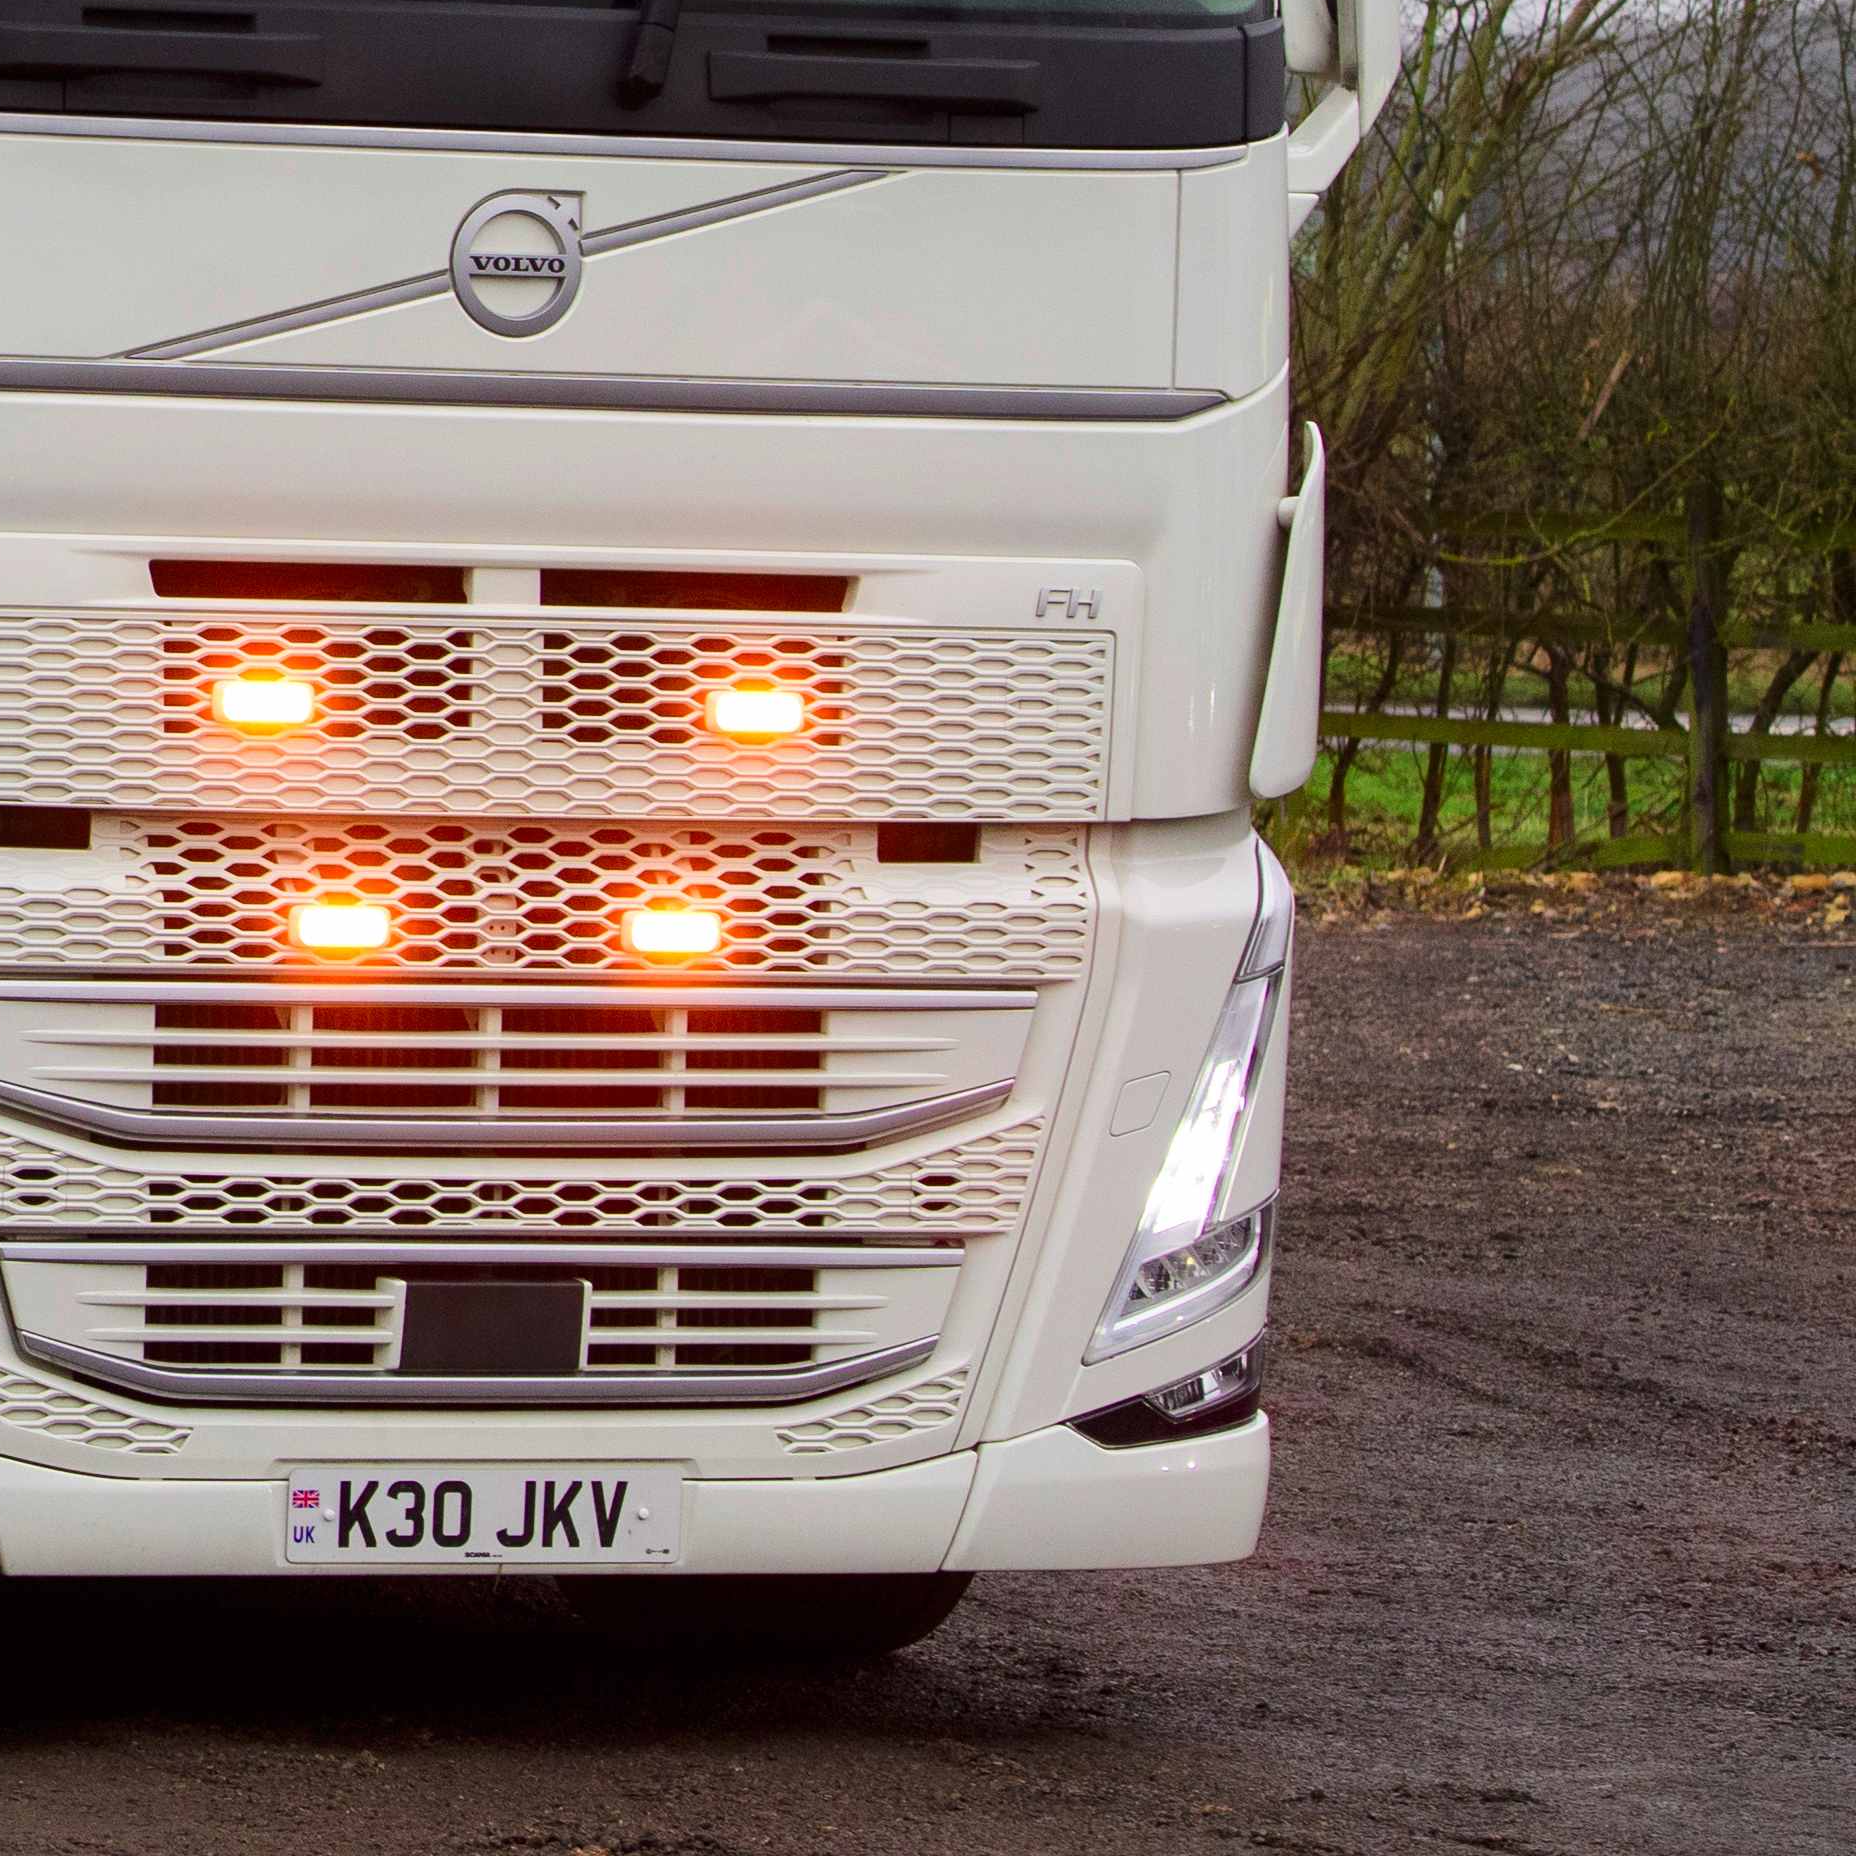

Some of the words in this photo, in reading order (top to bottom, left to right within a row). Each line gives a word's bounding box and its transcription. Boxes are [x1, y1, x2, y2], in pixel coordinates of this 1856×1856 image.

[470, 256, 565, 273] VOLVO
[1035, 584, 1104, 619] FH
[338, 1480, 472, 1548] K30
[496, 1480, 629, 1548] JKV
[293, 1525, 315, 1544] UK
